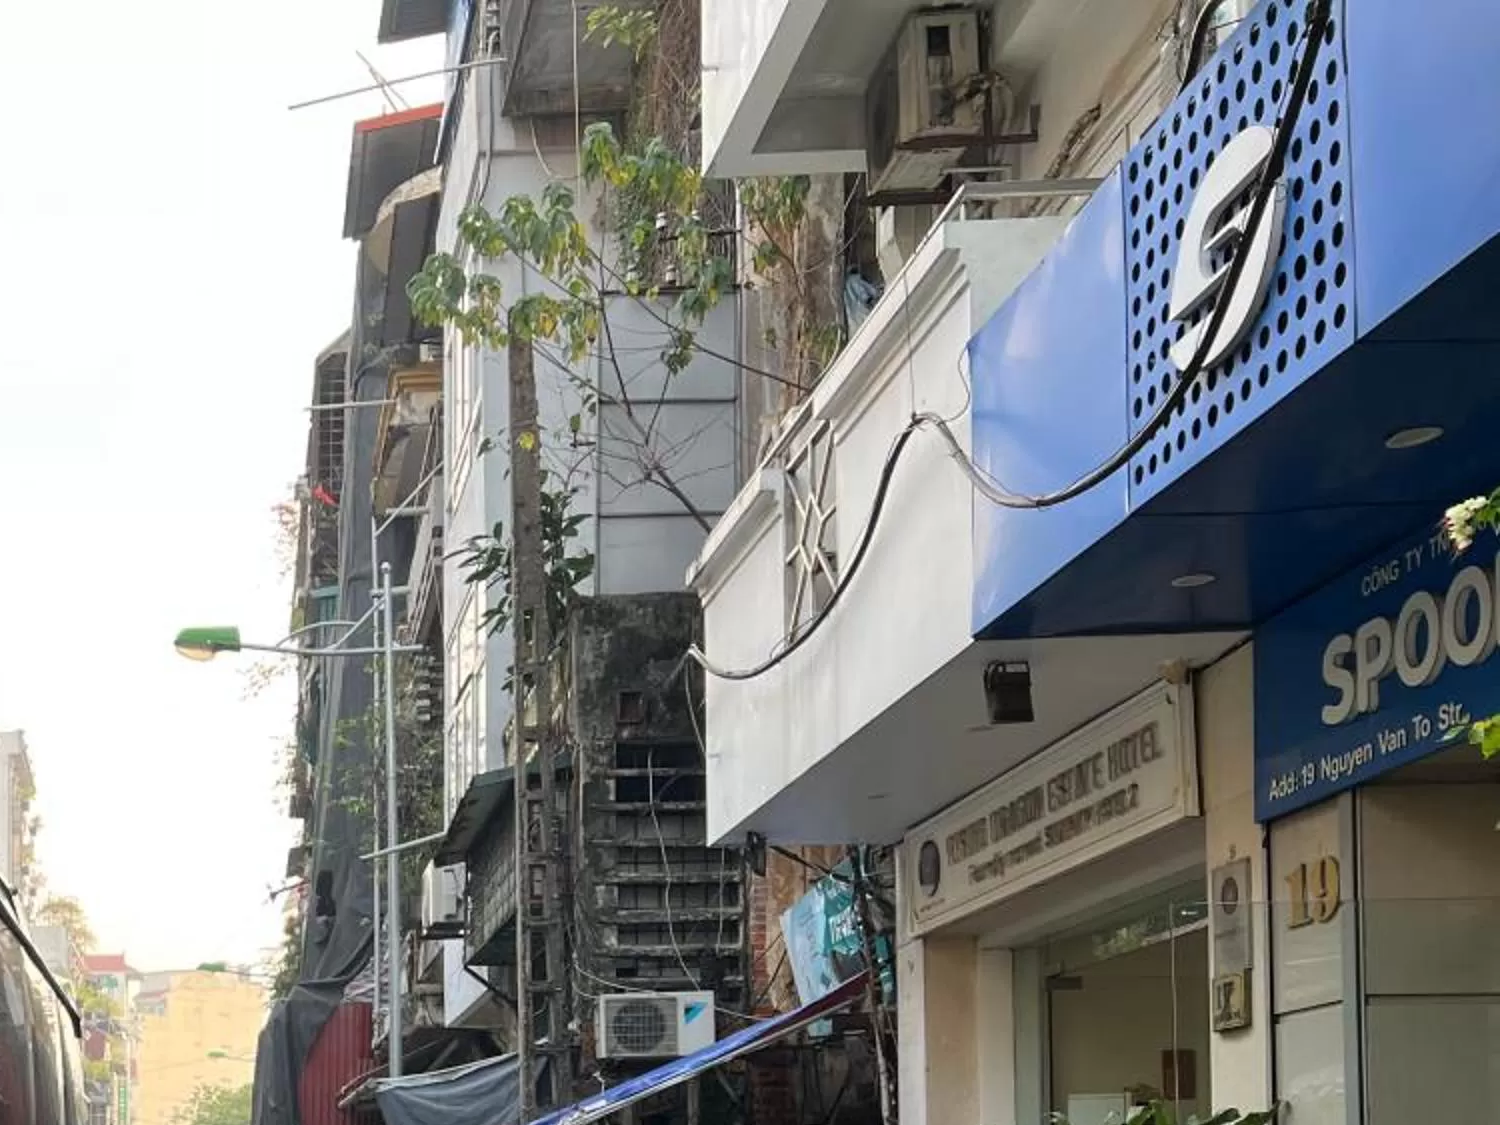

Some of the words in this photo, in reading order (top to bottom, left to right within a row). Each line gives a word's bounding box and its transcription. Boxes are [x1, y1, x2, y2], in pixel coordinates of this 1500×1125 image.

[1405, 544, 1423, 576] TY
[1321, 552, 1500, 726] SPOO
[1320, 740, 1374, 783] Nguyen
[1377, 724, 1407, 754] Van
[1411, 713, 1431, 739] To
[1284, 855, 1343, 930] 19
